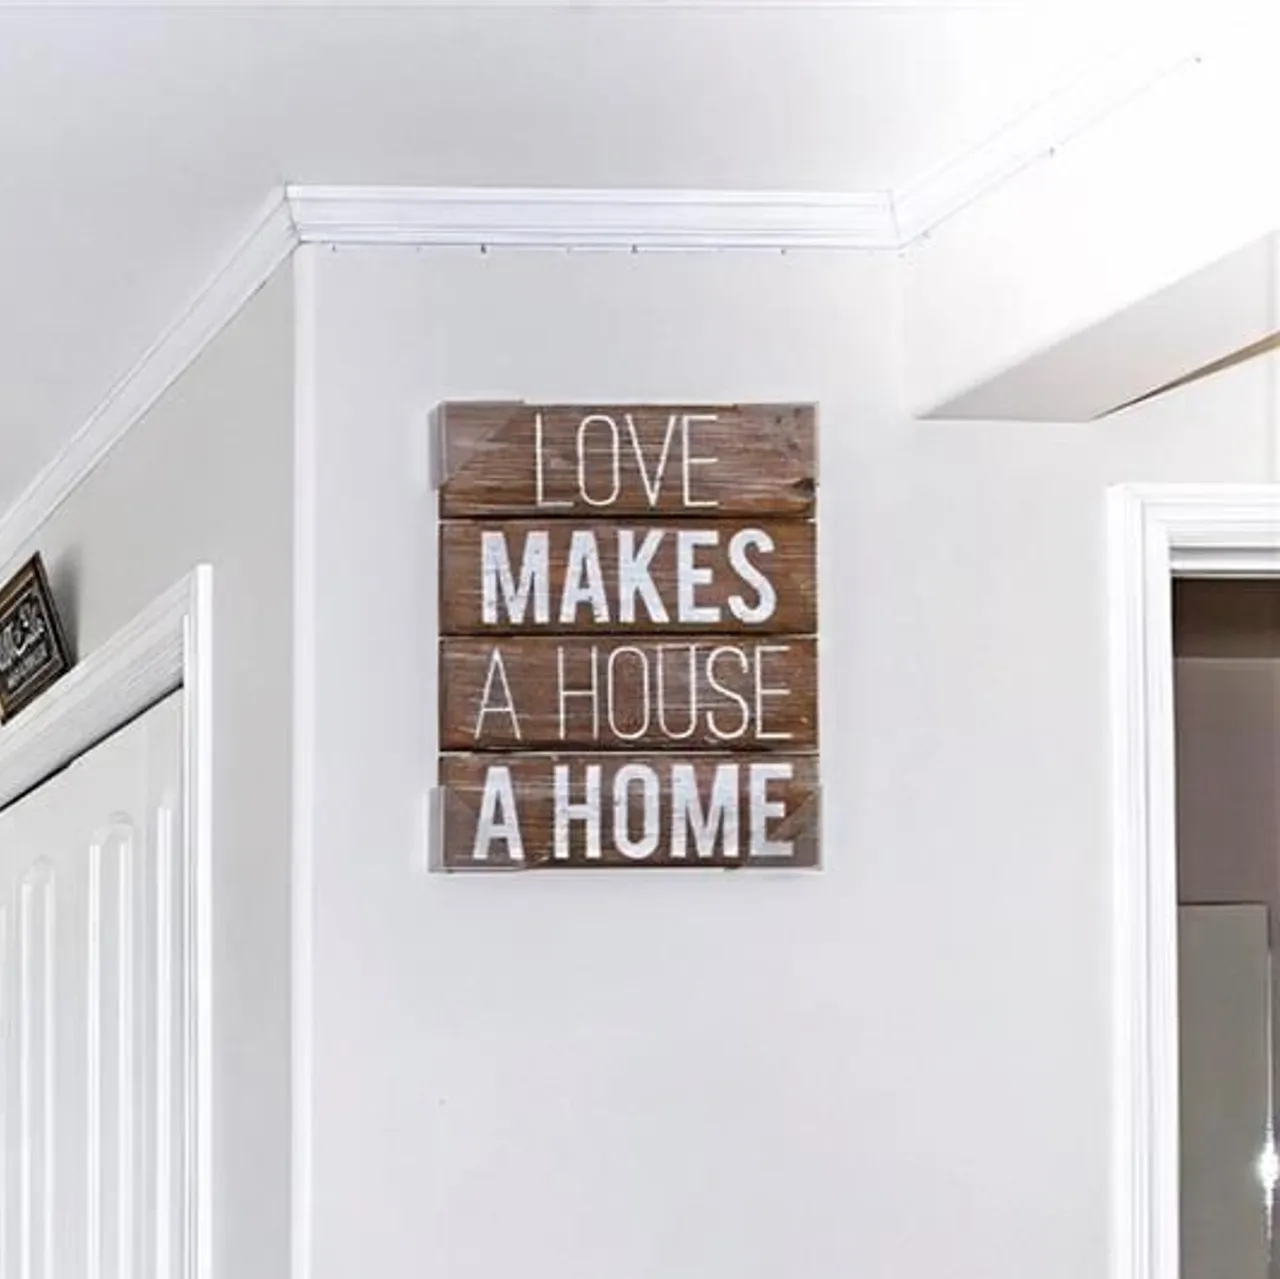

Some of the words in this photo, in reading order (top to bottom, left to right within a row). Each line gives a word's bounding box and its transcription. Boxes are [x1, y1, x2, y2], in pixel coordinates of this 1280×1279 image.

[536, 414, 719, 506] LOVE
[481, 528, 777, 624] MAKES
[473, 648, 521, 740] A
[557, 645, 793, 740] HOUSE
[473, 766, 525, 860] A
[553, 763, 794, 859] HOME
